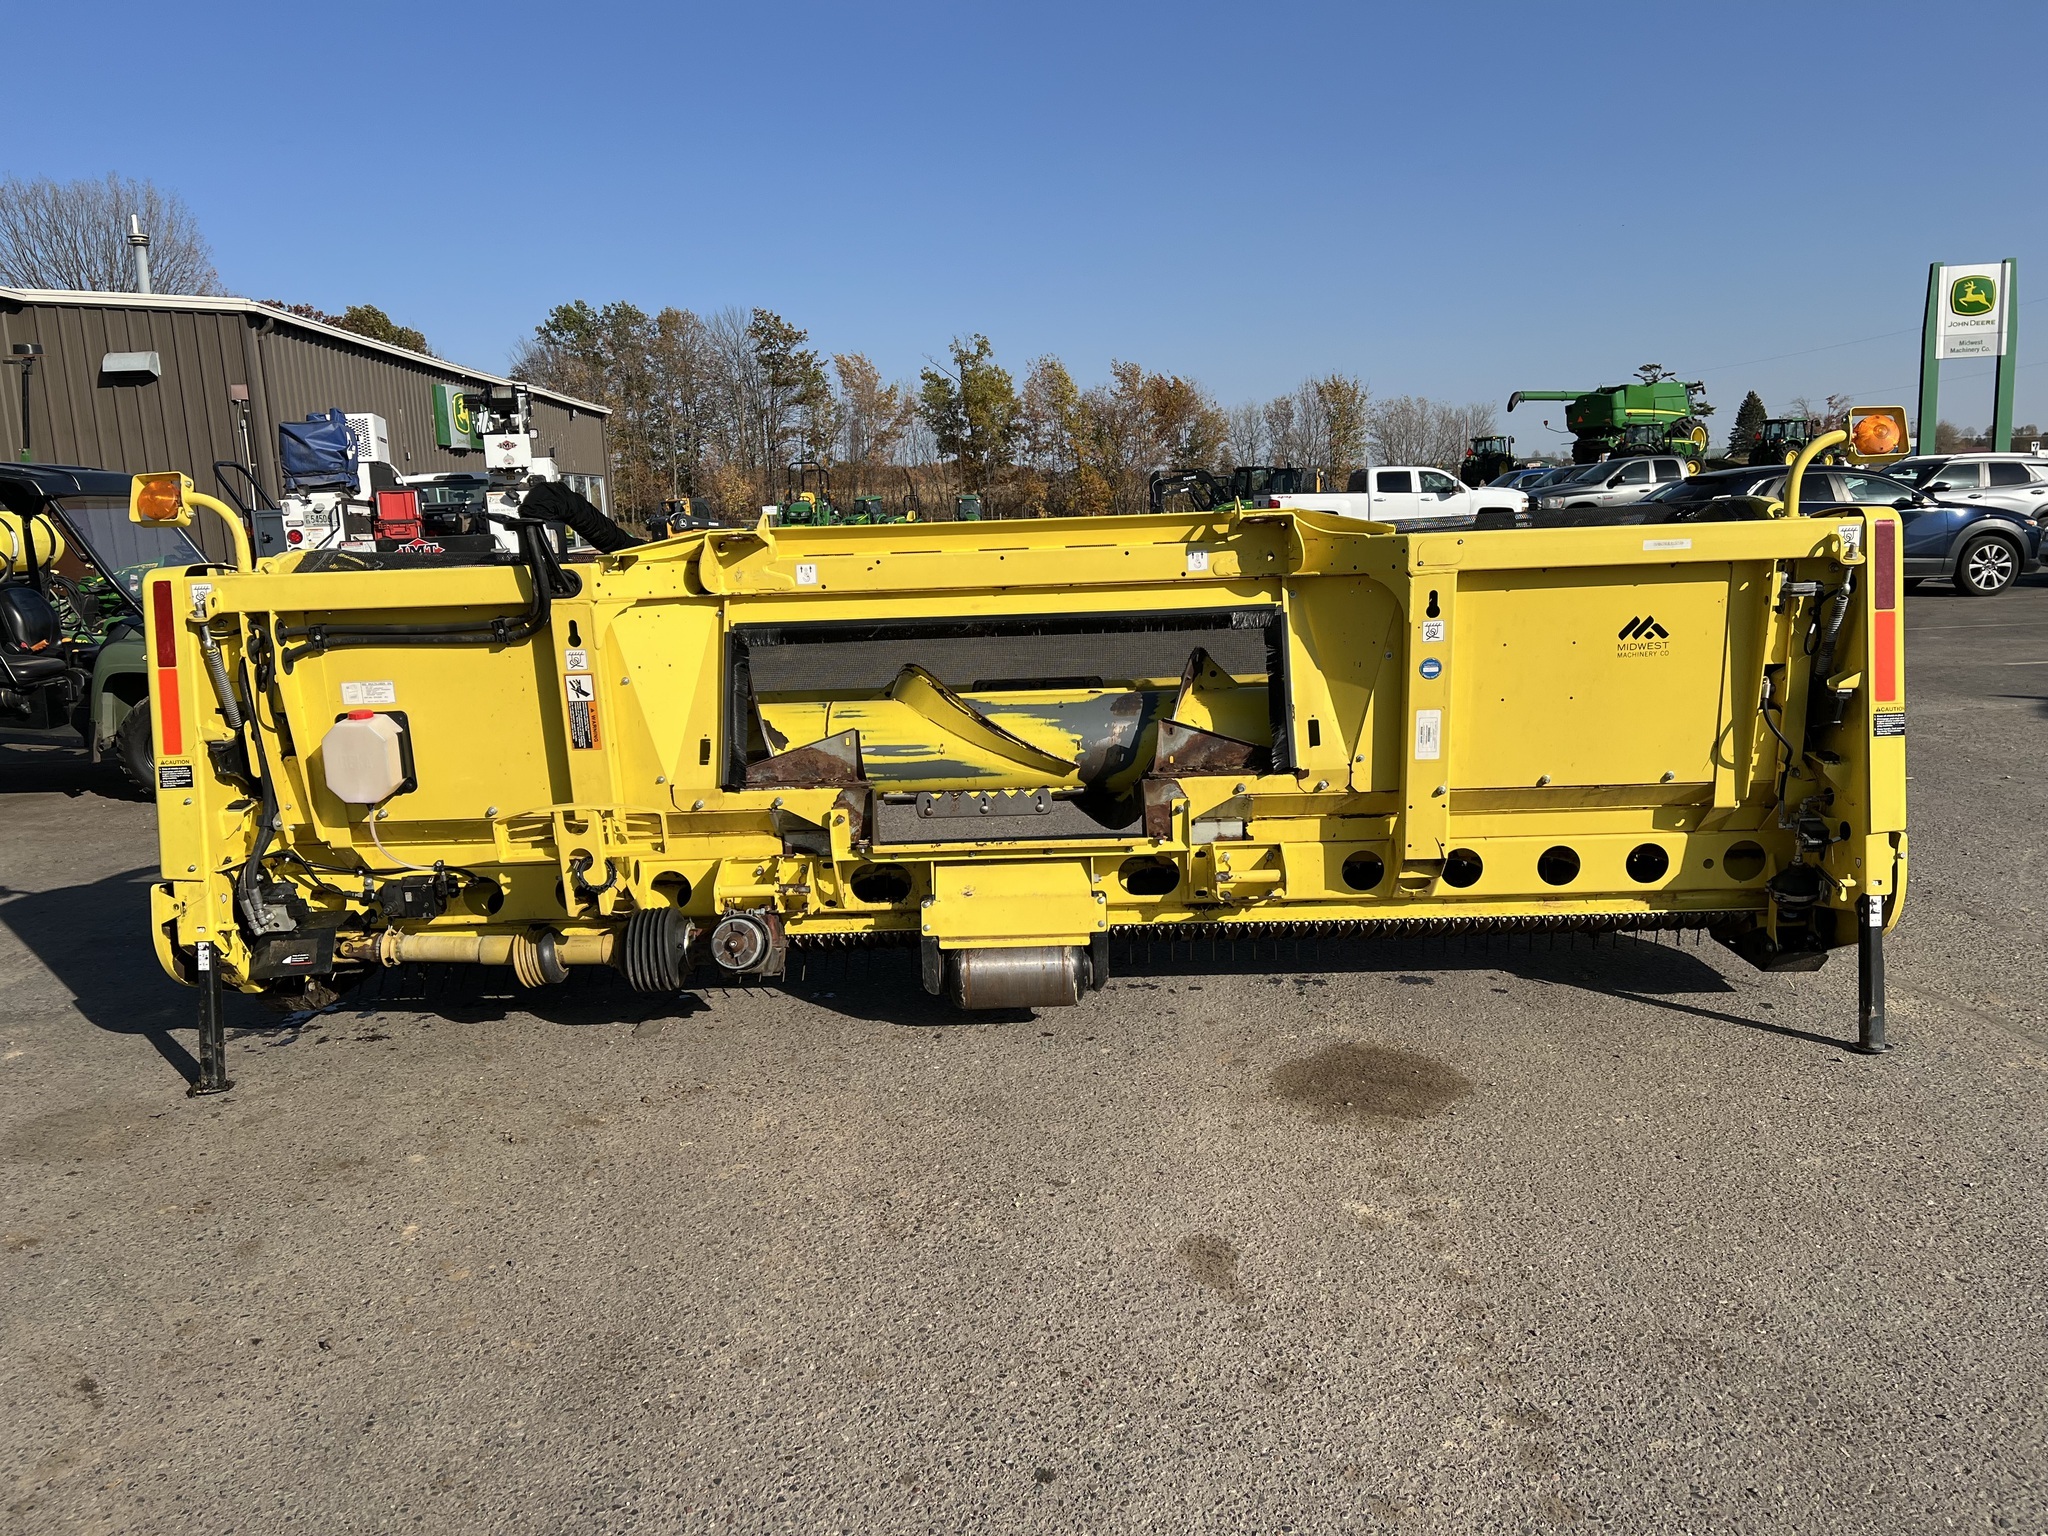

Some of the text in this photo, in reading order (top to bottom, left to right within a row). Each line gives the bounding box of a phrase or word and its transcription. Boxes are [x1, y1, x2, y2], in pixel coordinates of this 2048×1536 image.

[1948, 319, 1996, 328] JOHN DEERE
[1617, 641, 1670, 651] MIDWEST
[1617, 650, 1658, 658] MACHINERY
[591, 714, 599, 742] WARNING
